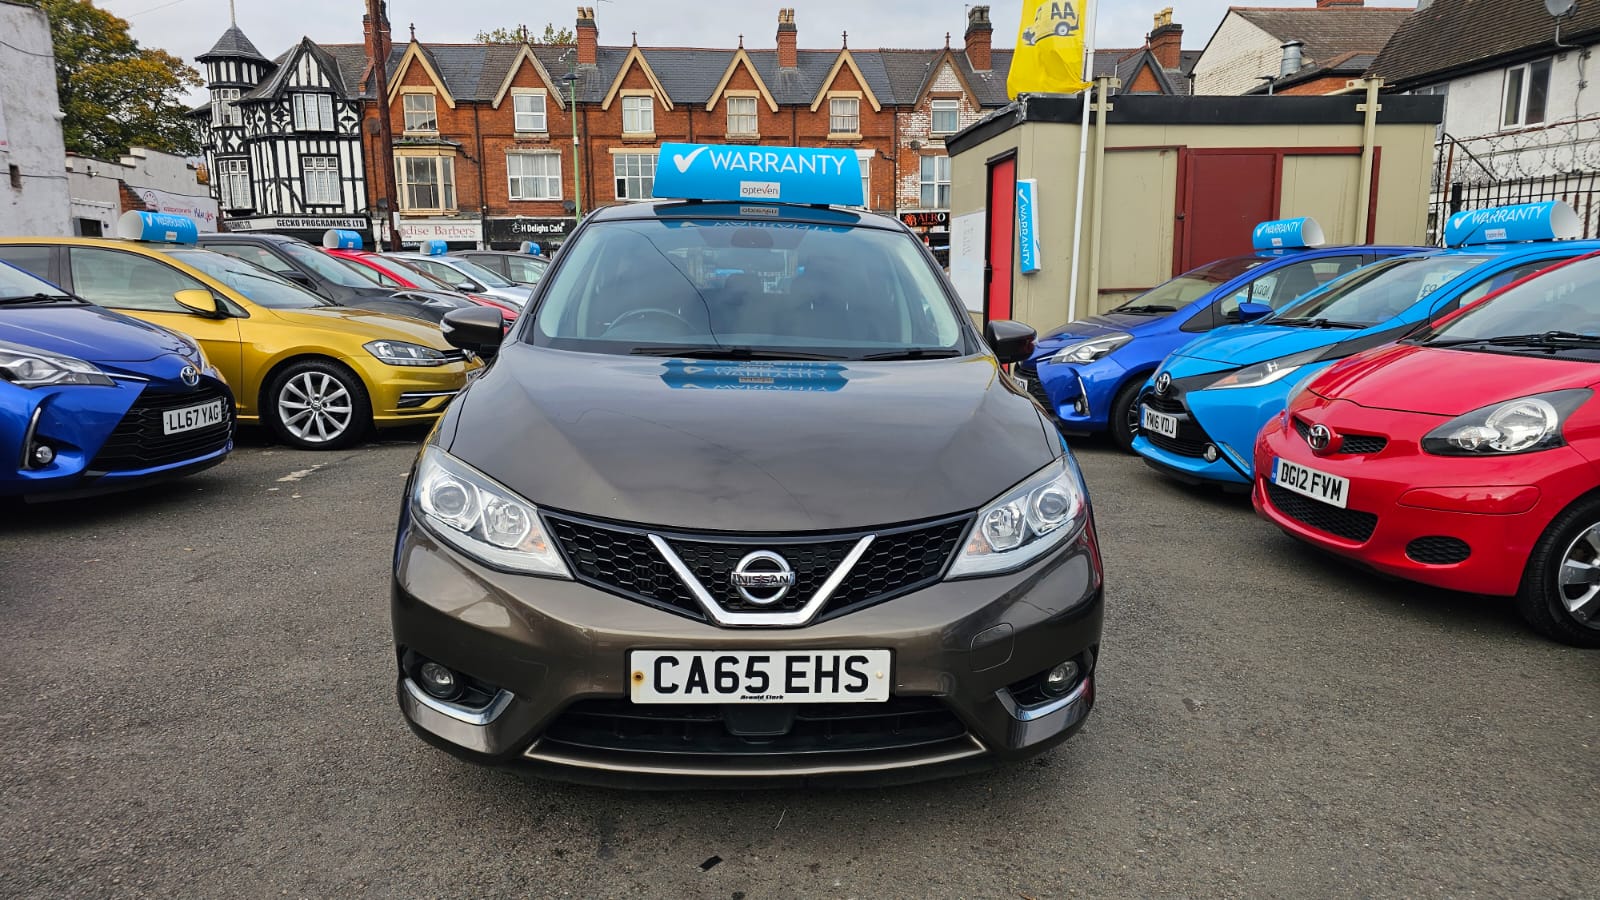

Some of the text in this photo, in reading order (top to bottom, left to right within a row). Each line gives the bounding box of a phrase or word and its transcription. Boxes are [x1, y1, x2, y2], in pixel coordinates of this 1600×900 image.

[1051, 2, 1076, 20] AA
[709, 150, 847, 175] WARRANTY
[742, 184, 778, 195] opteven
[276, 218, 365, 228] GECKO PROGRAMMES LTD
[1471, 205, 1547, 224] WARRANTY
[434, 225, 475, 235] Barbers
[1020, 204, 1030, 266] WARRANTY
[1265, 221, 1300, 234] WARRANTY
[169, 404, 219, 431] LL67 YAG
[1161, 416, 1175, 433] VDJ
[1281, 462, 1342, 501] DG12 FVM
[737, 574, 789, 586] NISSAN
[653, 655, 869, 694] CA65 EHS
